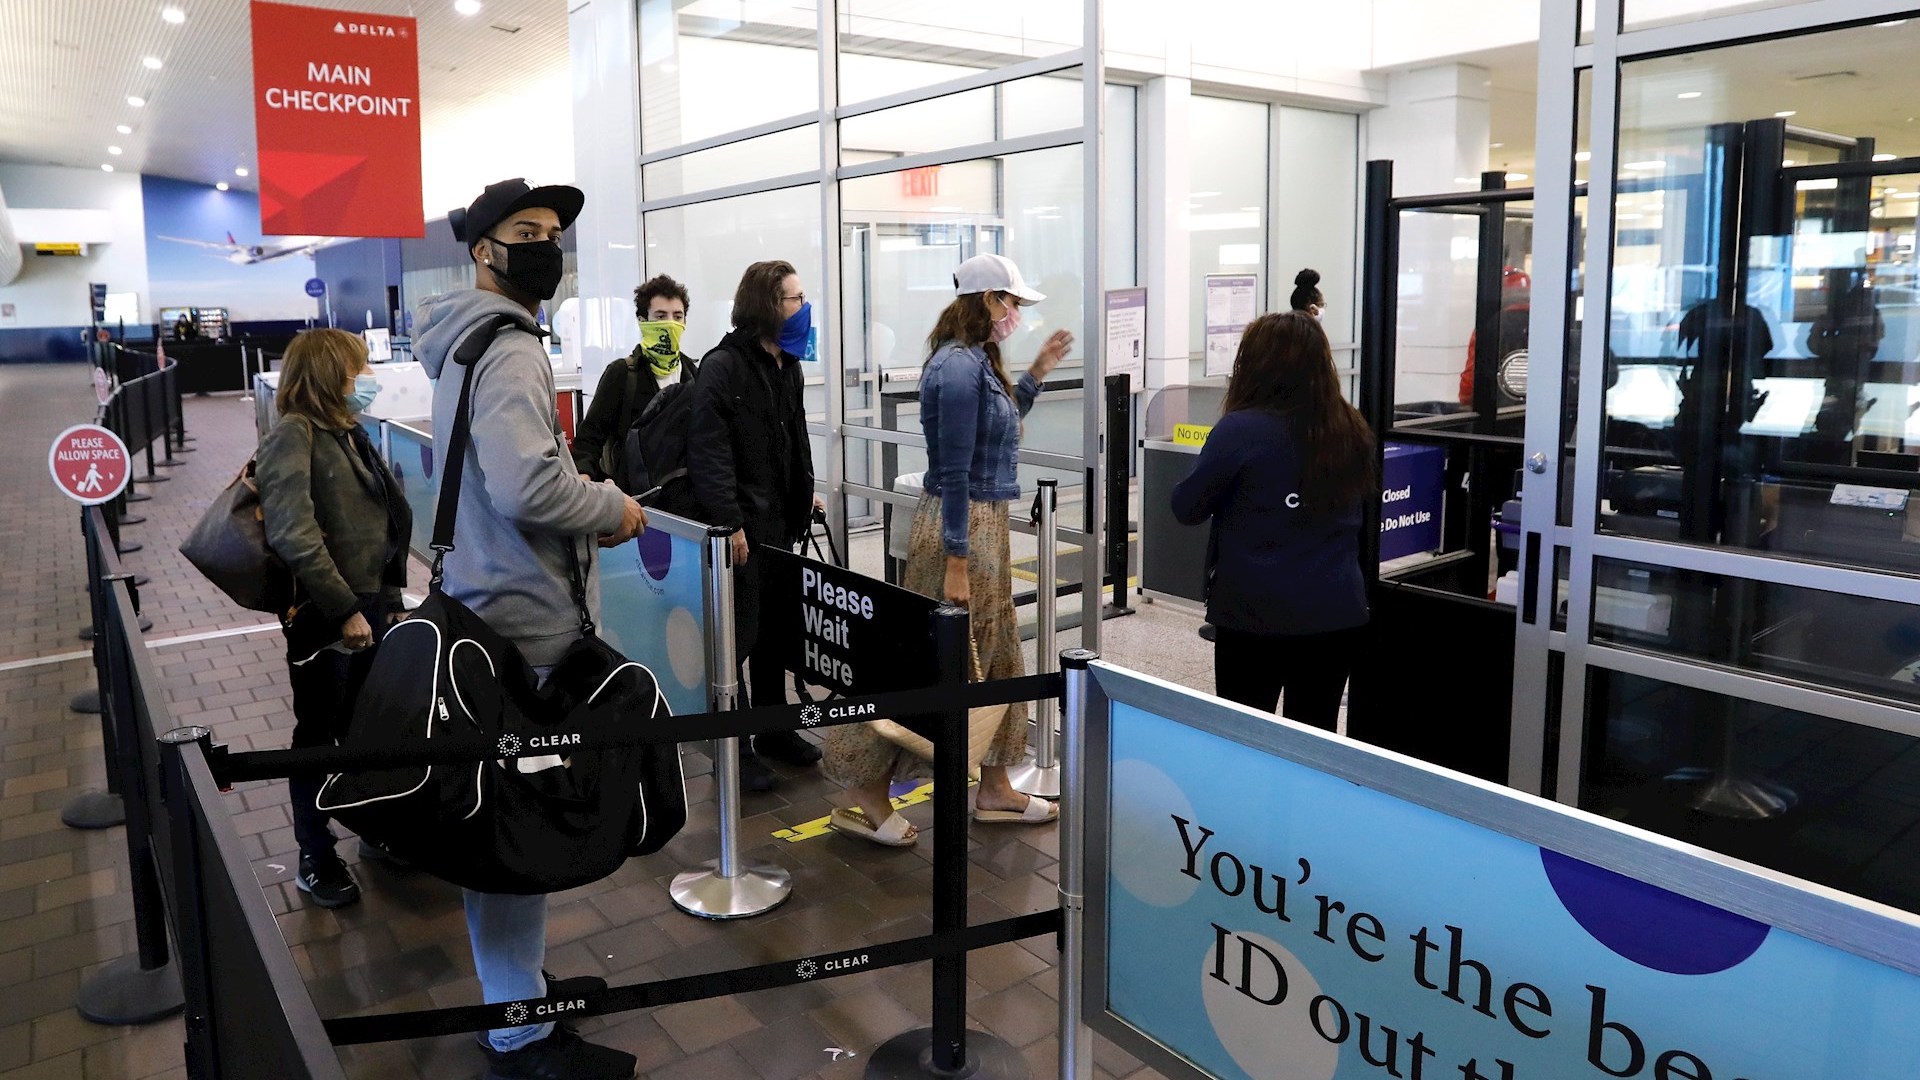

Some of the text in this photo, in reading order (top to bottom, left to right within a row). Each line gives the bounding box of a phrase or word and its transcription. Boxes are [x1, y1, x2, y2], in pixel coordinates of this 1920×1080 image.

[349, 23, 395, 37] DELTA
[307, 61, 371, 86] MAIN
[265, 87, 411, 117] CHECKPOINT
[71, 437, 104, 448] PLEASE
[1177, 427, 1191, 439] No
[58, 448, 120, 461] ALLOW SPACE
[1382, 484, 1411, 503] Closed
[1385, 518, 1398, 531] Do
[1398, 513, 1415, 528] Not
[1415, 510, 1431, 524] Use
[802, 566, 874, 620] Please
[802, 602, 850, 649] Wait
[805, 639, 853, 687] Here
[829, 703, 876, 718] CLEAR
[529, 733, 581, 748] CLEAR
[1170, 813, 1386, 963] You're
[1409, 924, 1553, 1039] the
[824, 954, 869, 971] CLEAR
[536, 999, 586, 1015] CLEAR
[1209, 922, 1436, 1080] ID out
